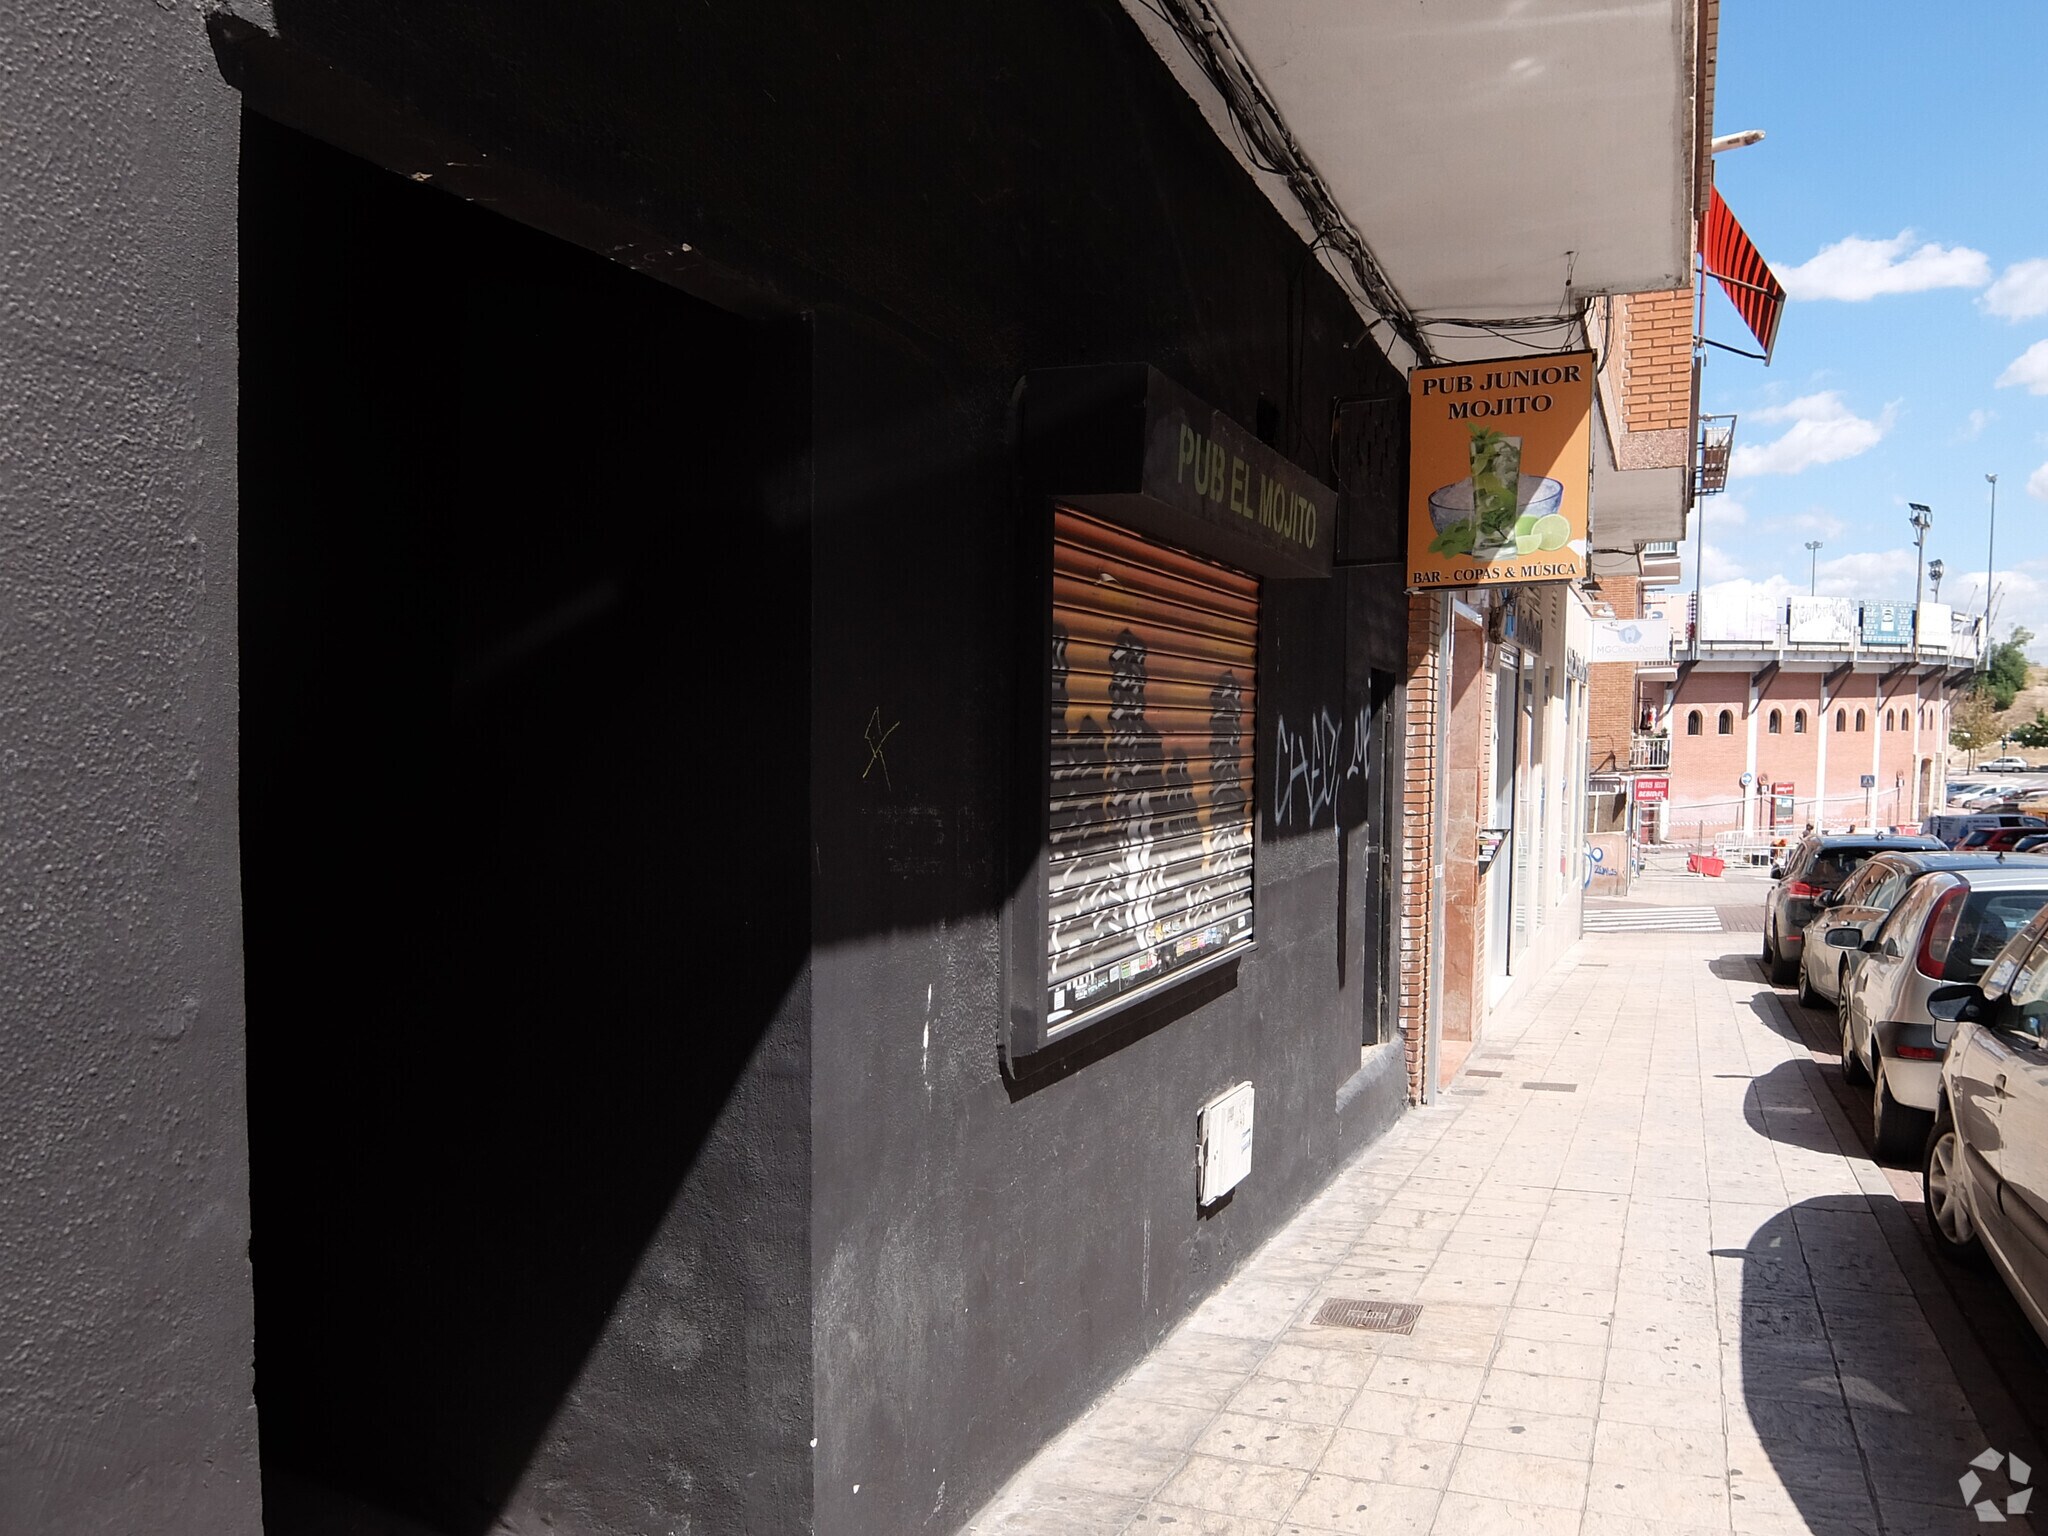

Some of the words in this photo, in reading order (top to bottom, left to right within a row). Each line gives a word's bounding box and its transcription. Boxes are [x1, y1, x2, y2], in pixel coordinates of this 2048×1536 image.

[1422, 375, 1474, 396] PUB
[1480, 365, 1582, 391] JUNIOR
[1448, 394, 1553, 420] MOJITO
[1177, 423, 1226, 504] PUB
[1230, 456, 1254, 520] EL
[1259, 473, 1318, 550] MOJITO
[1412, 570, 1441, 584] BAR
[1453, 567, 1501, 582] COPAS
[1504, 566, 1517, 578] &
[1520, 562, 1577, 578] MÚSICA
